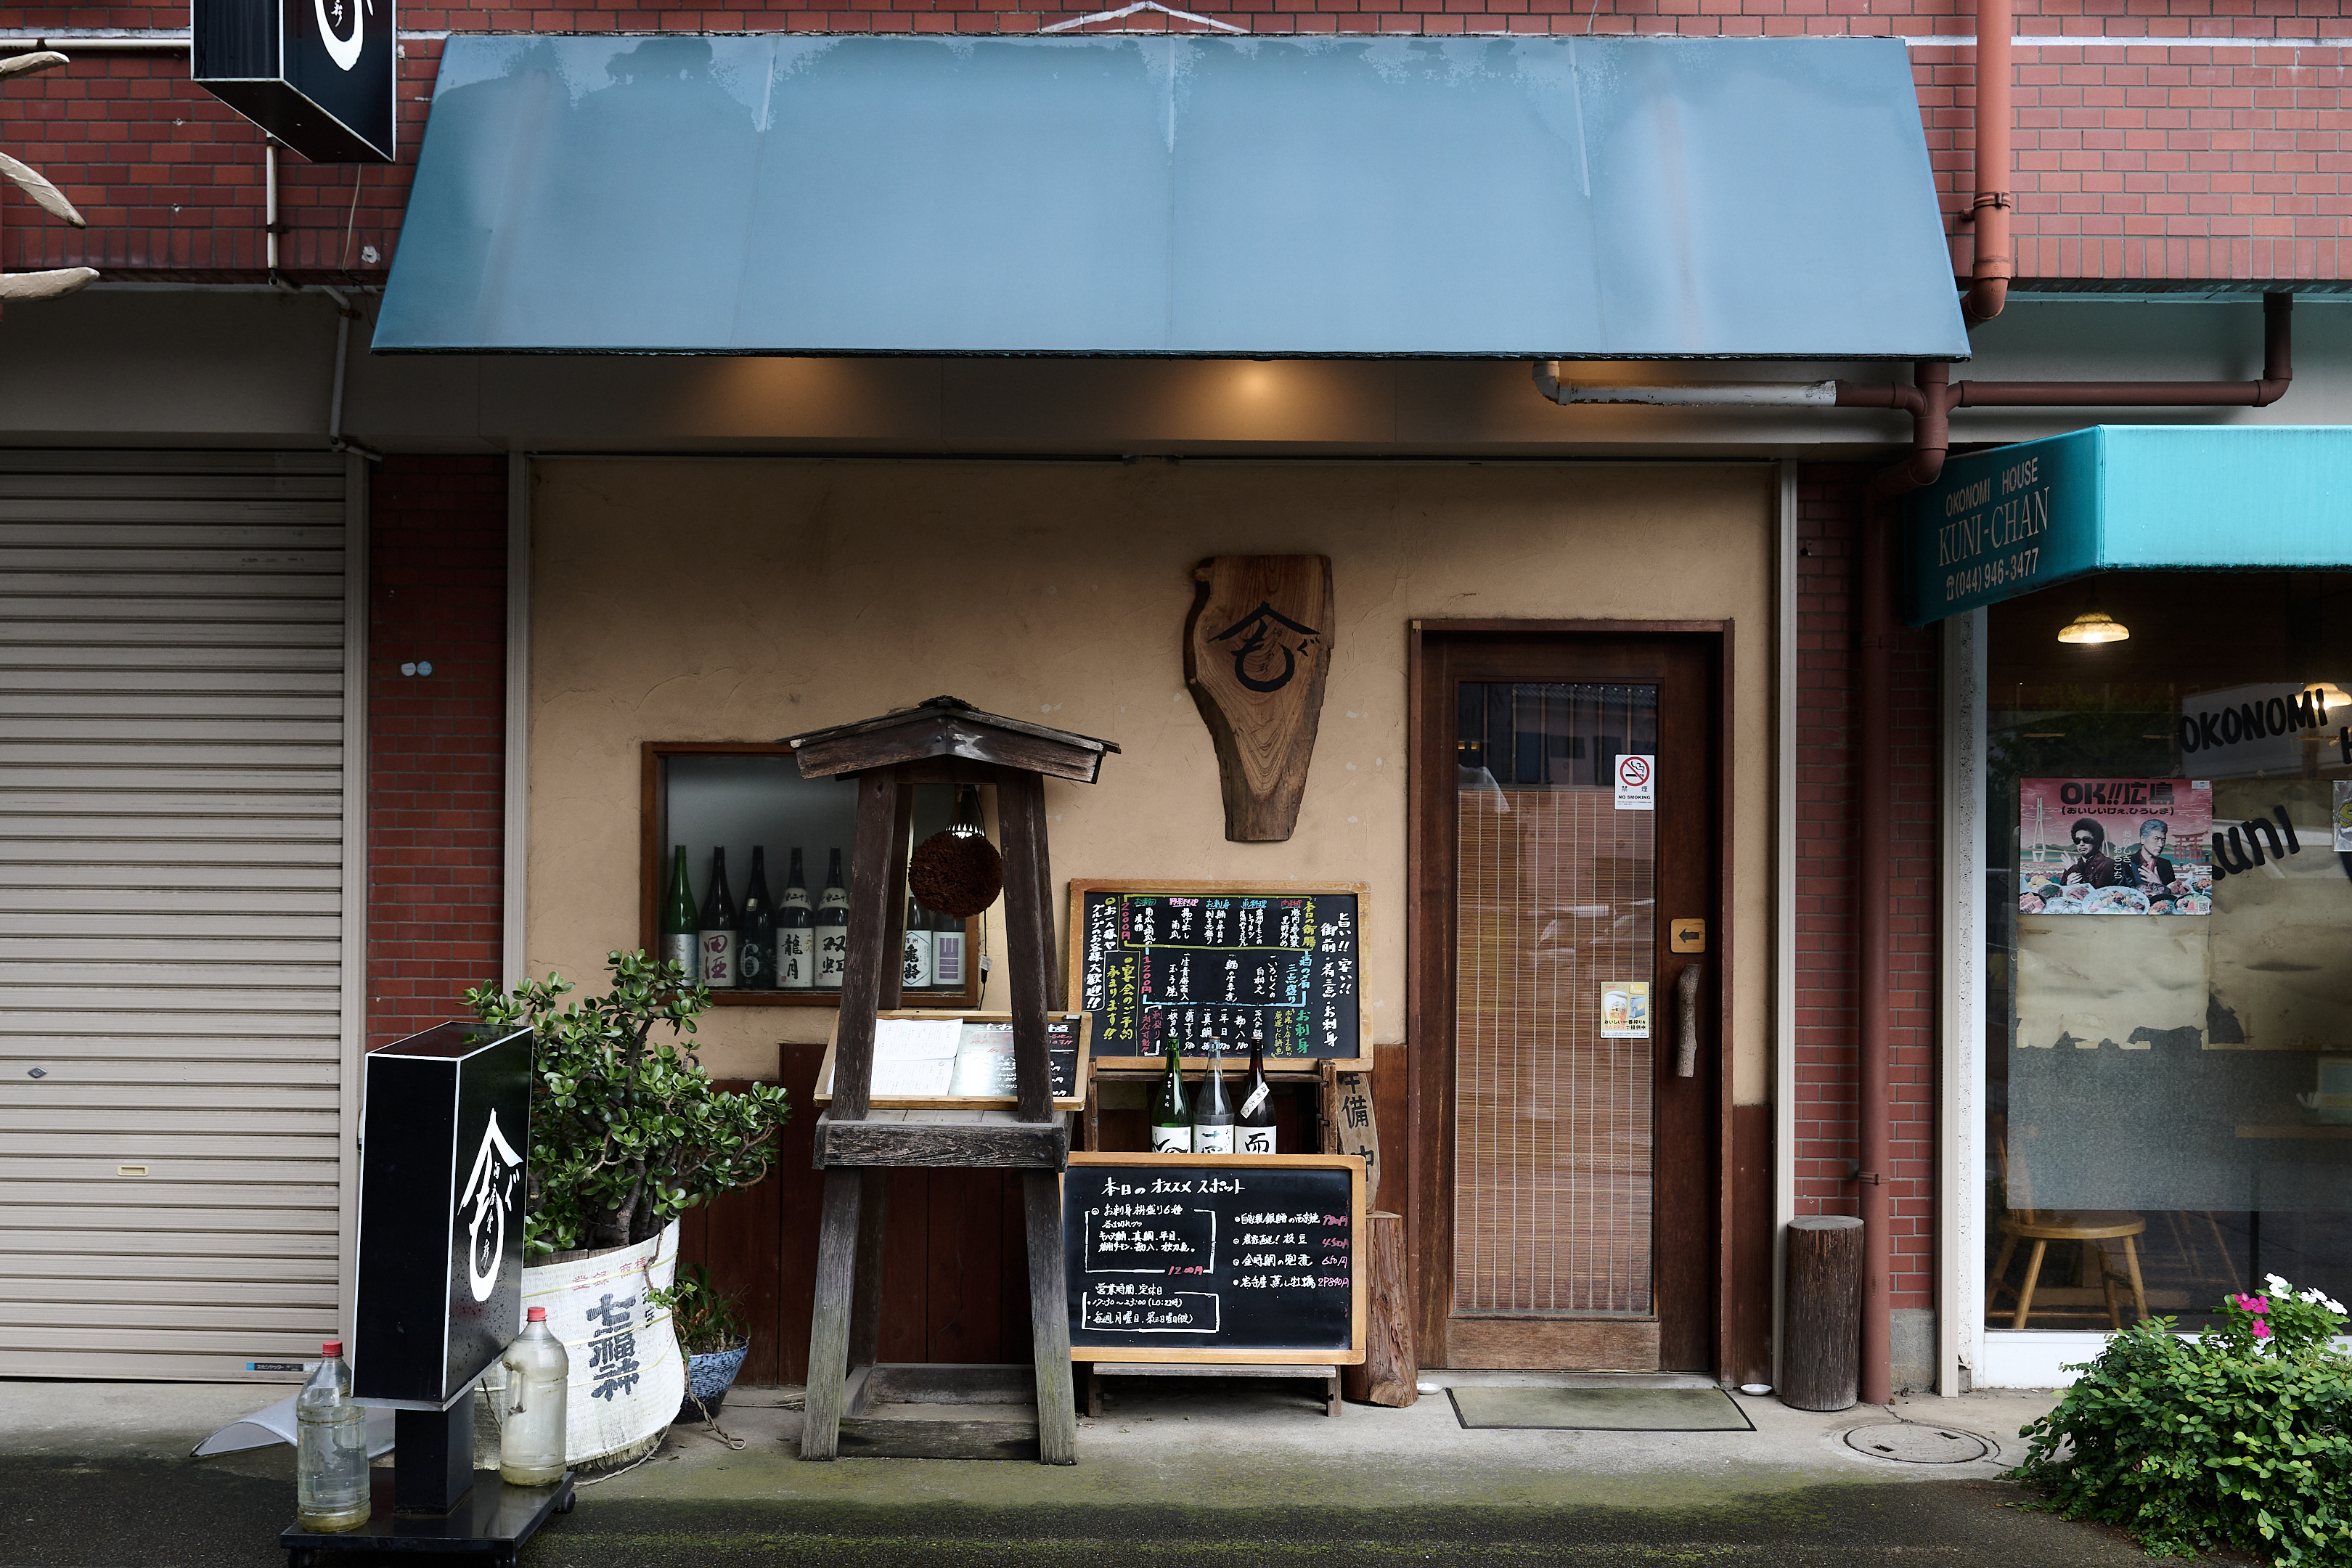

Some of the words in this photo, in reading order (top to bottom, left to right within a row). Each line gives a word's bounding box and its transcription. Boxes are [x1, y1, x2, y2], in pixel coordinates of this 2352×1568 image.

[1946, 478, 1990, 518] OKONOMI
[2002, 457, 2038, 495] HOUSE
[1939, 486, 2050, 567] KUNI-CHAN
[1985, 547, 2039, 589] 946-3477
[2178, 688, 2328, 753] OKONOMI
[2113, 846, 2123, 880] おちこち
[1206, 899, 1230, 909] お刺身
[704, 935, 728, 980] 田酒
[740, 944, 760, 978] 6
[781, 934, 803, 980] 龍月
[1295, 1009, 1311, 1053] お刺身
[1101, 1176, 1146, 1196] 本日の
[1151, 1177, 1192, 1193] オススメ
[1197, 1177, 1246, 1194] スポット
[587, 1293, 640, 1402] 七福神
